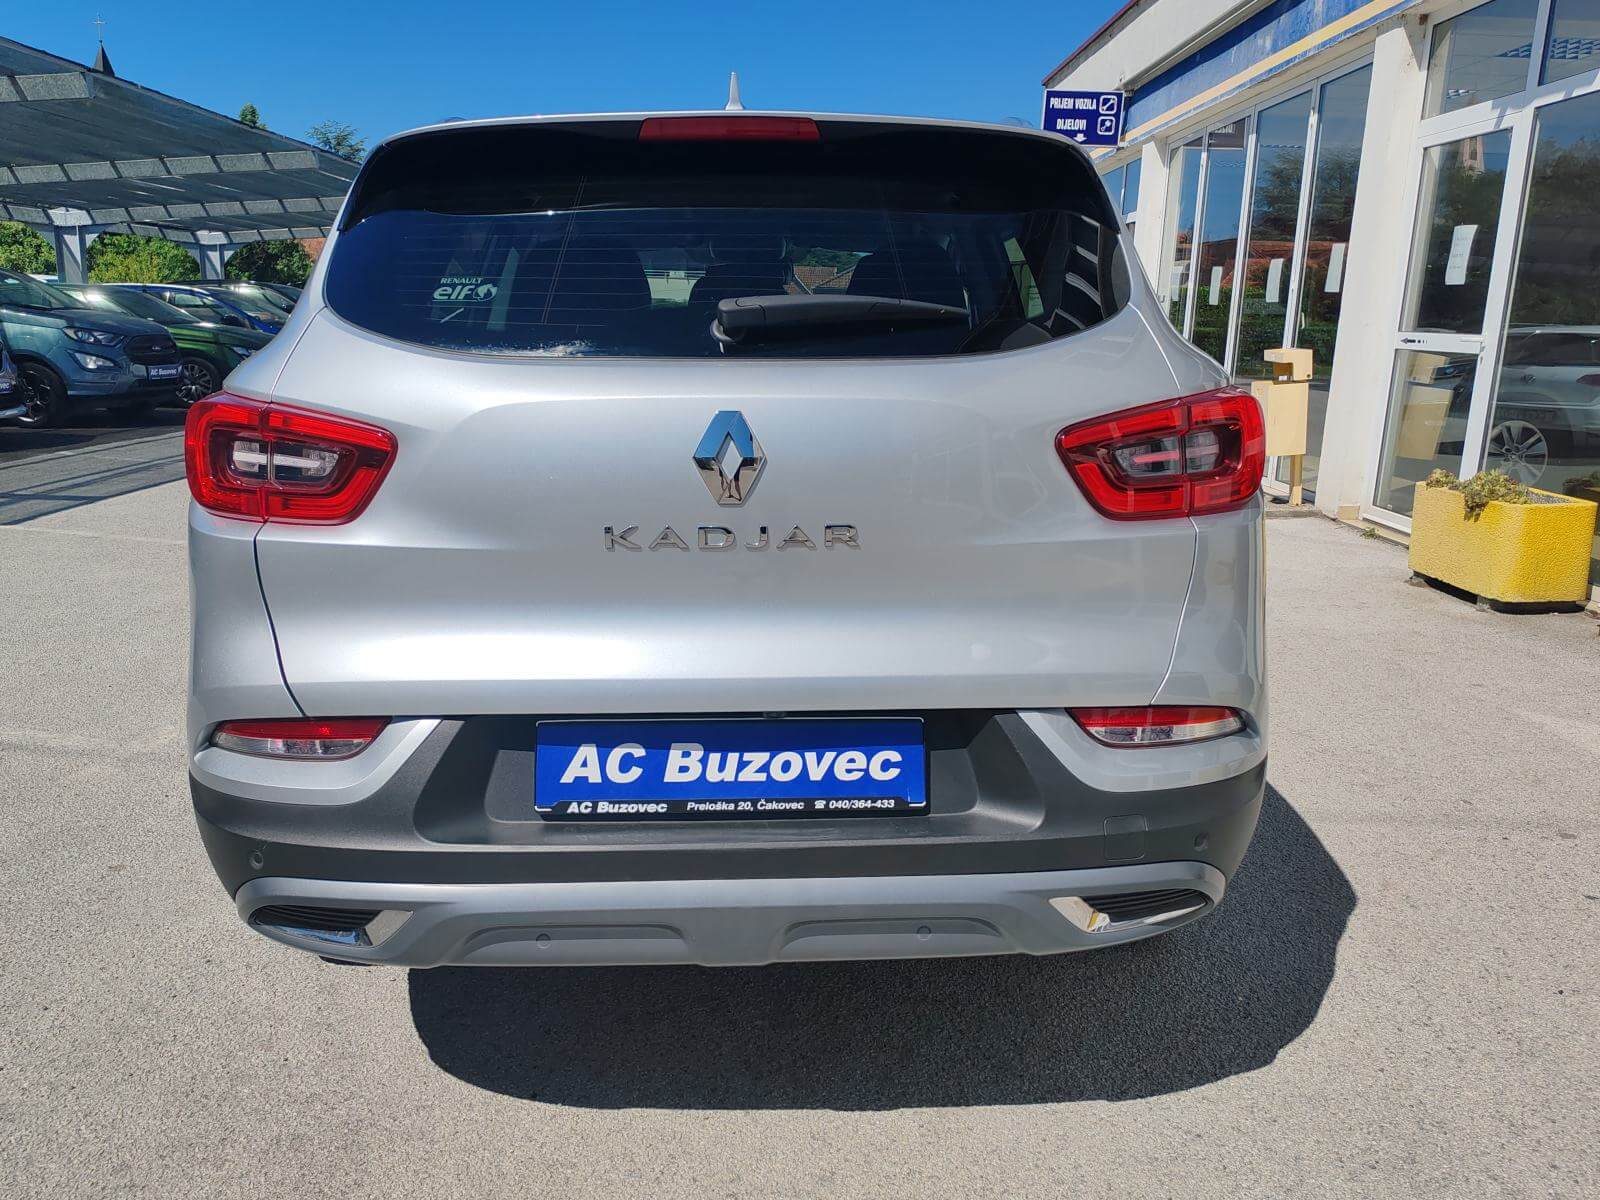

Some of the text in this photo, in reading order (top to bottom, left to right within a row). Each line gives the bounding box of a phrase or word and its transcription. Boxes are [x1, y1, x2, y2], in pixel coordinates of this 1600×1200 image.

[1050, 97, 1097, 110] PRIJEM VOZILA
[1056, 118, 1087, 130] DIJELOVI
[433, 285, 475, 300] elf
[603, 524, 861, 551] KADJAR
[560, 742, 903, 784] AC Buzovec
[566, 798, 895, 814] AC Buzovec Preloška 20, Čakovec 040/364-433
